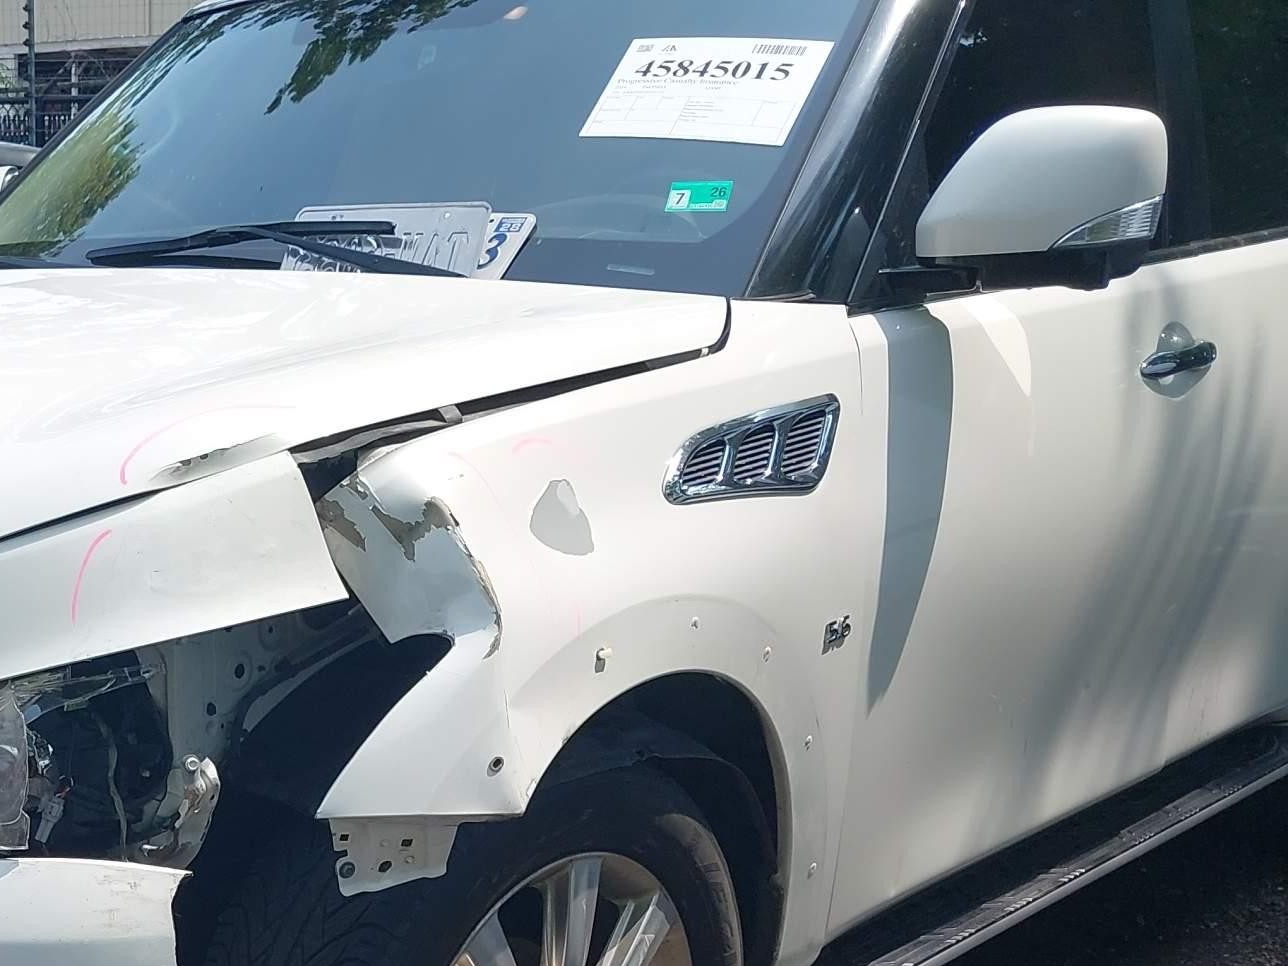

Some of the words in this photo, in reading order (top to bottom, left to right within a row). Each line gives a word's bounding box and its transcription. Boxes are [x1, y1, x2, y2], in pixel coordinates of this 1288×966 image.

[634, 59, 794, 81] 45845015
[710, 187, 727, 198] 26
[675, 192, 686, 206] 7
[499, 223, 521, 232] 28
